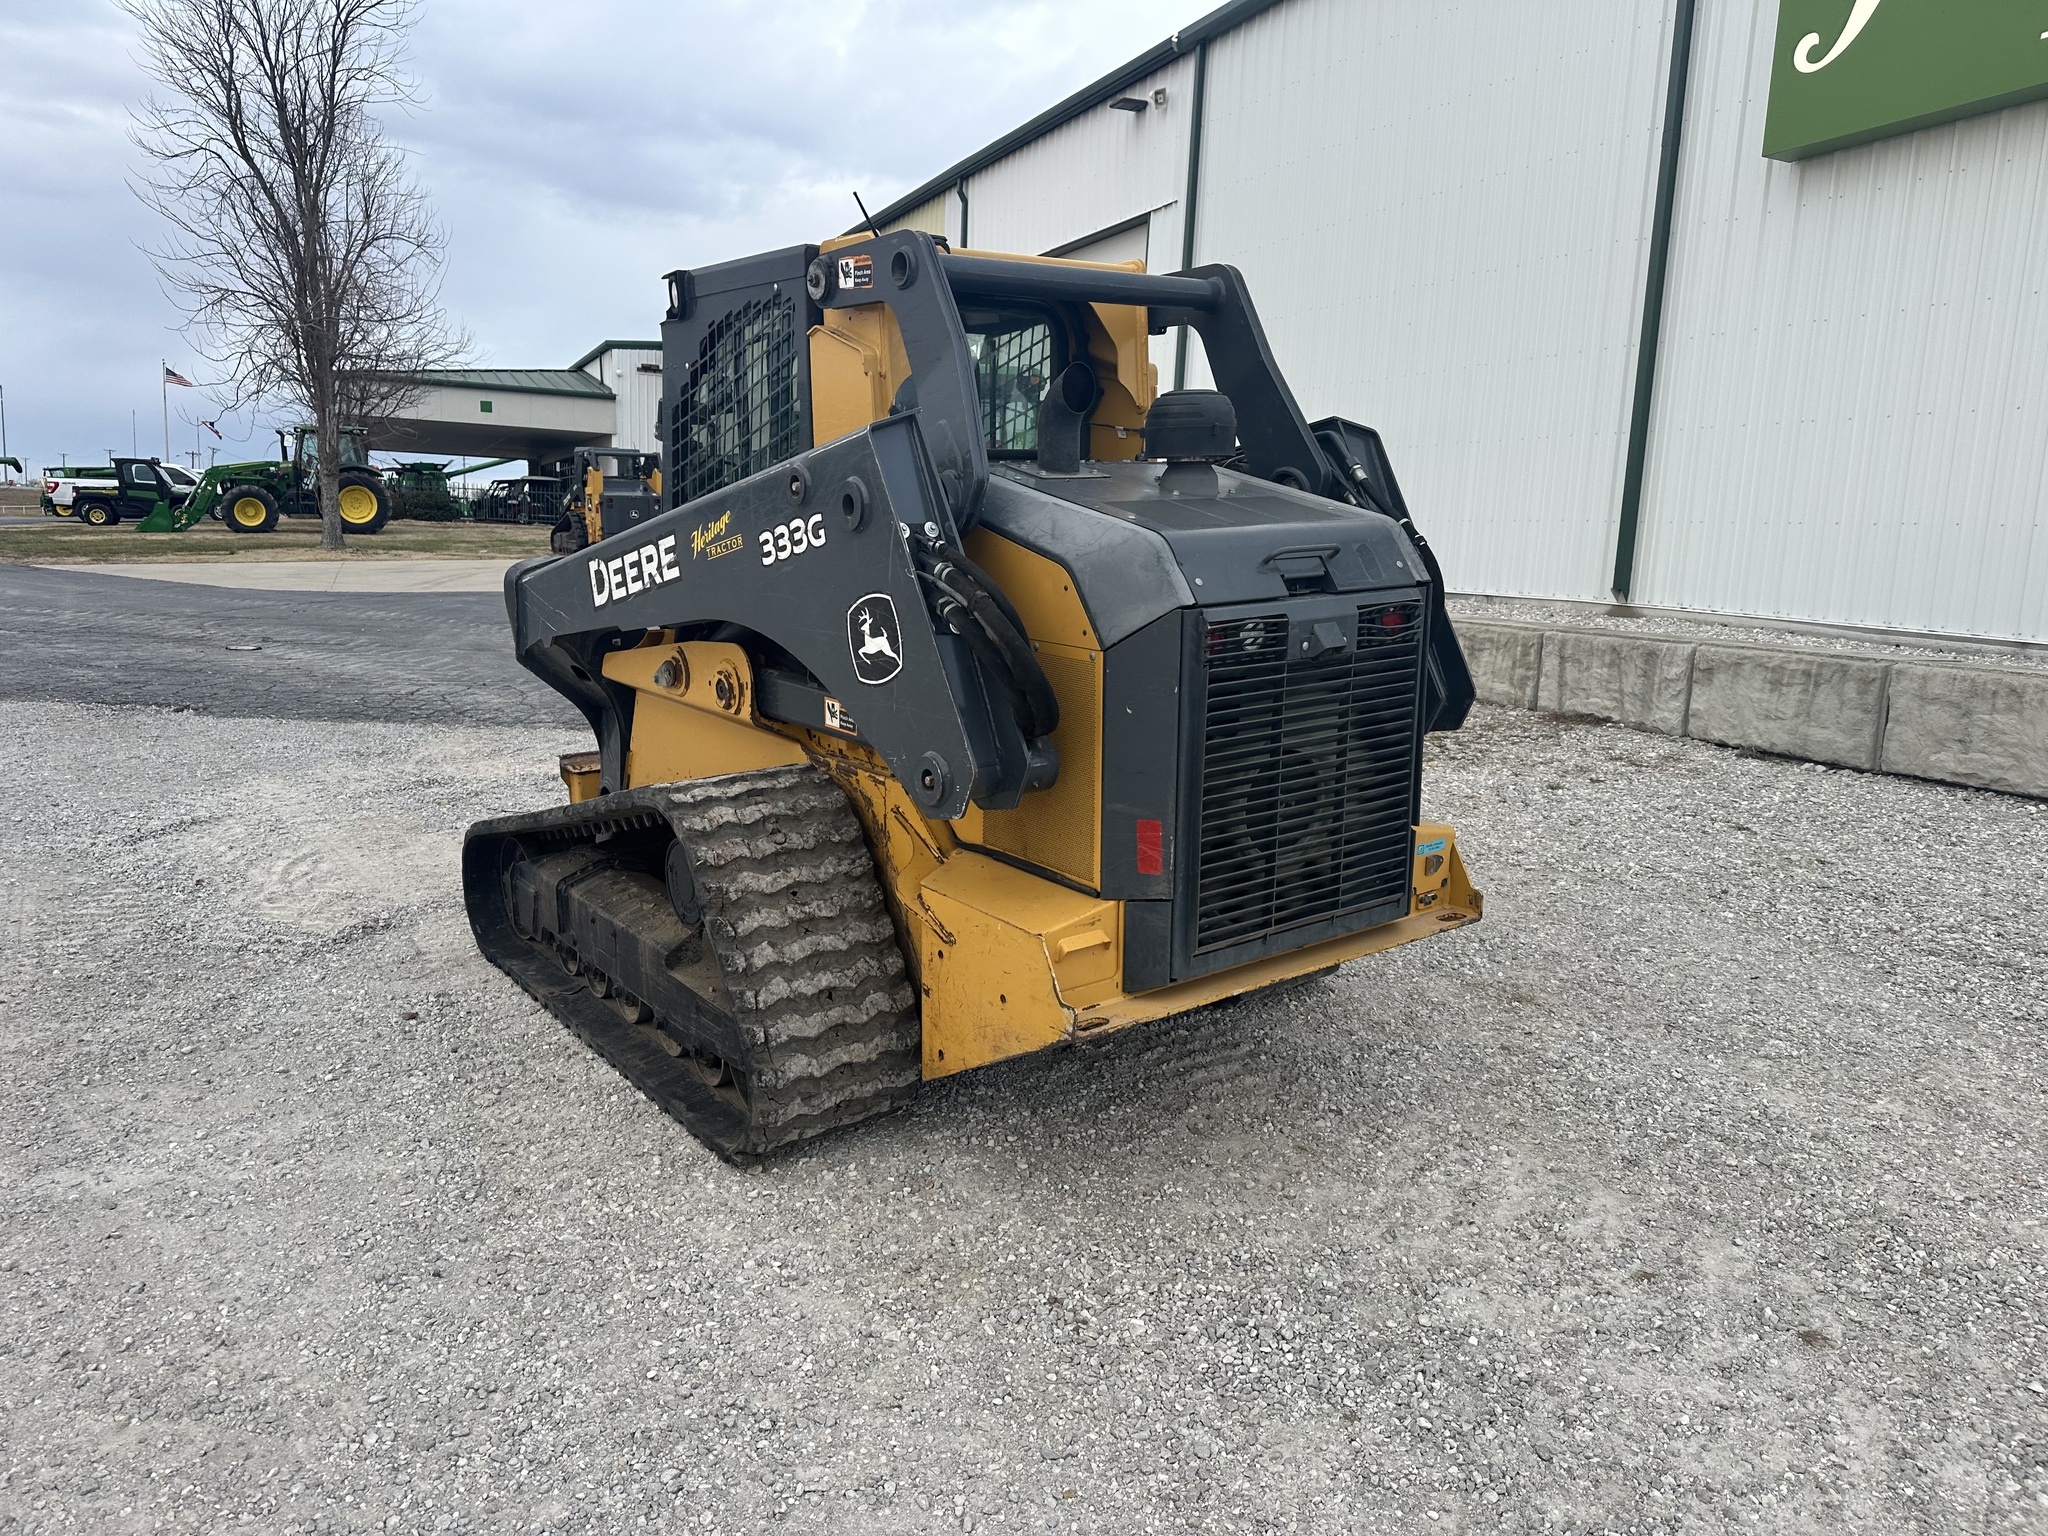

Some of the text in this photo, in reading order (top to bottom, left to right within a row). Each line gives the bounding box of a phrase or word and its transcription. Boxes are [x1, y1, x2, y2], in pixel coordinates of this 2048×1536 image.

[691, 509, 732, 559] Heritage
[706, 535, 743, 558] TRACTOR
[758, 513, 827, 566] 333G
[588, 534, 681, 607] DEERE
